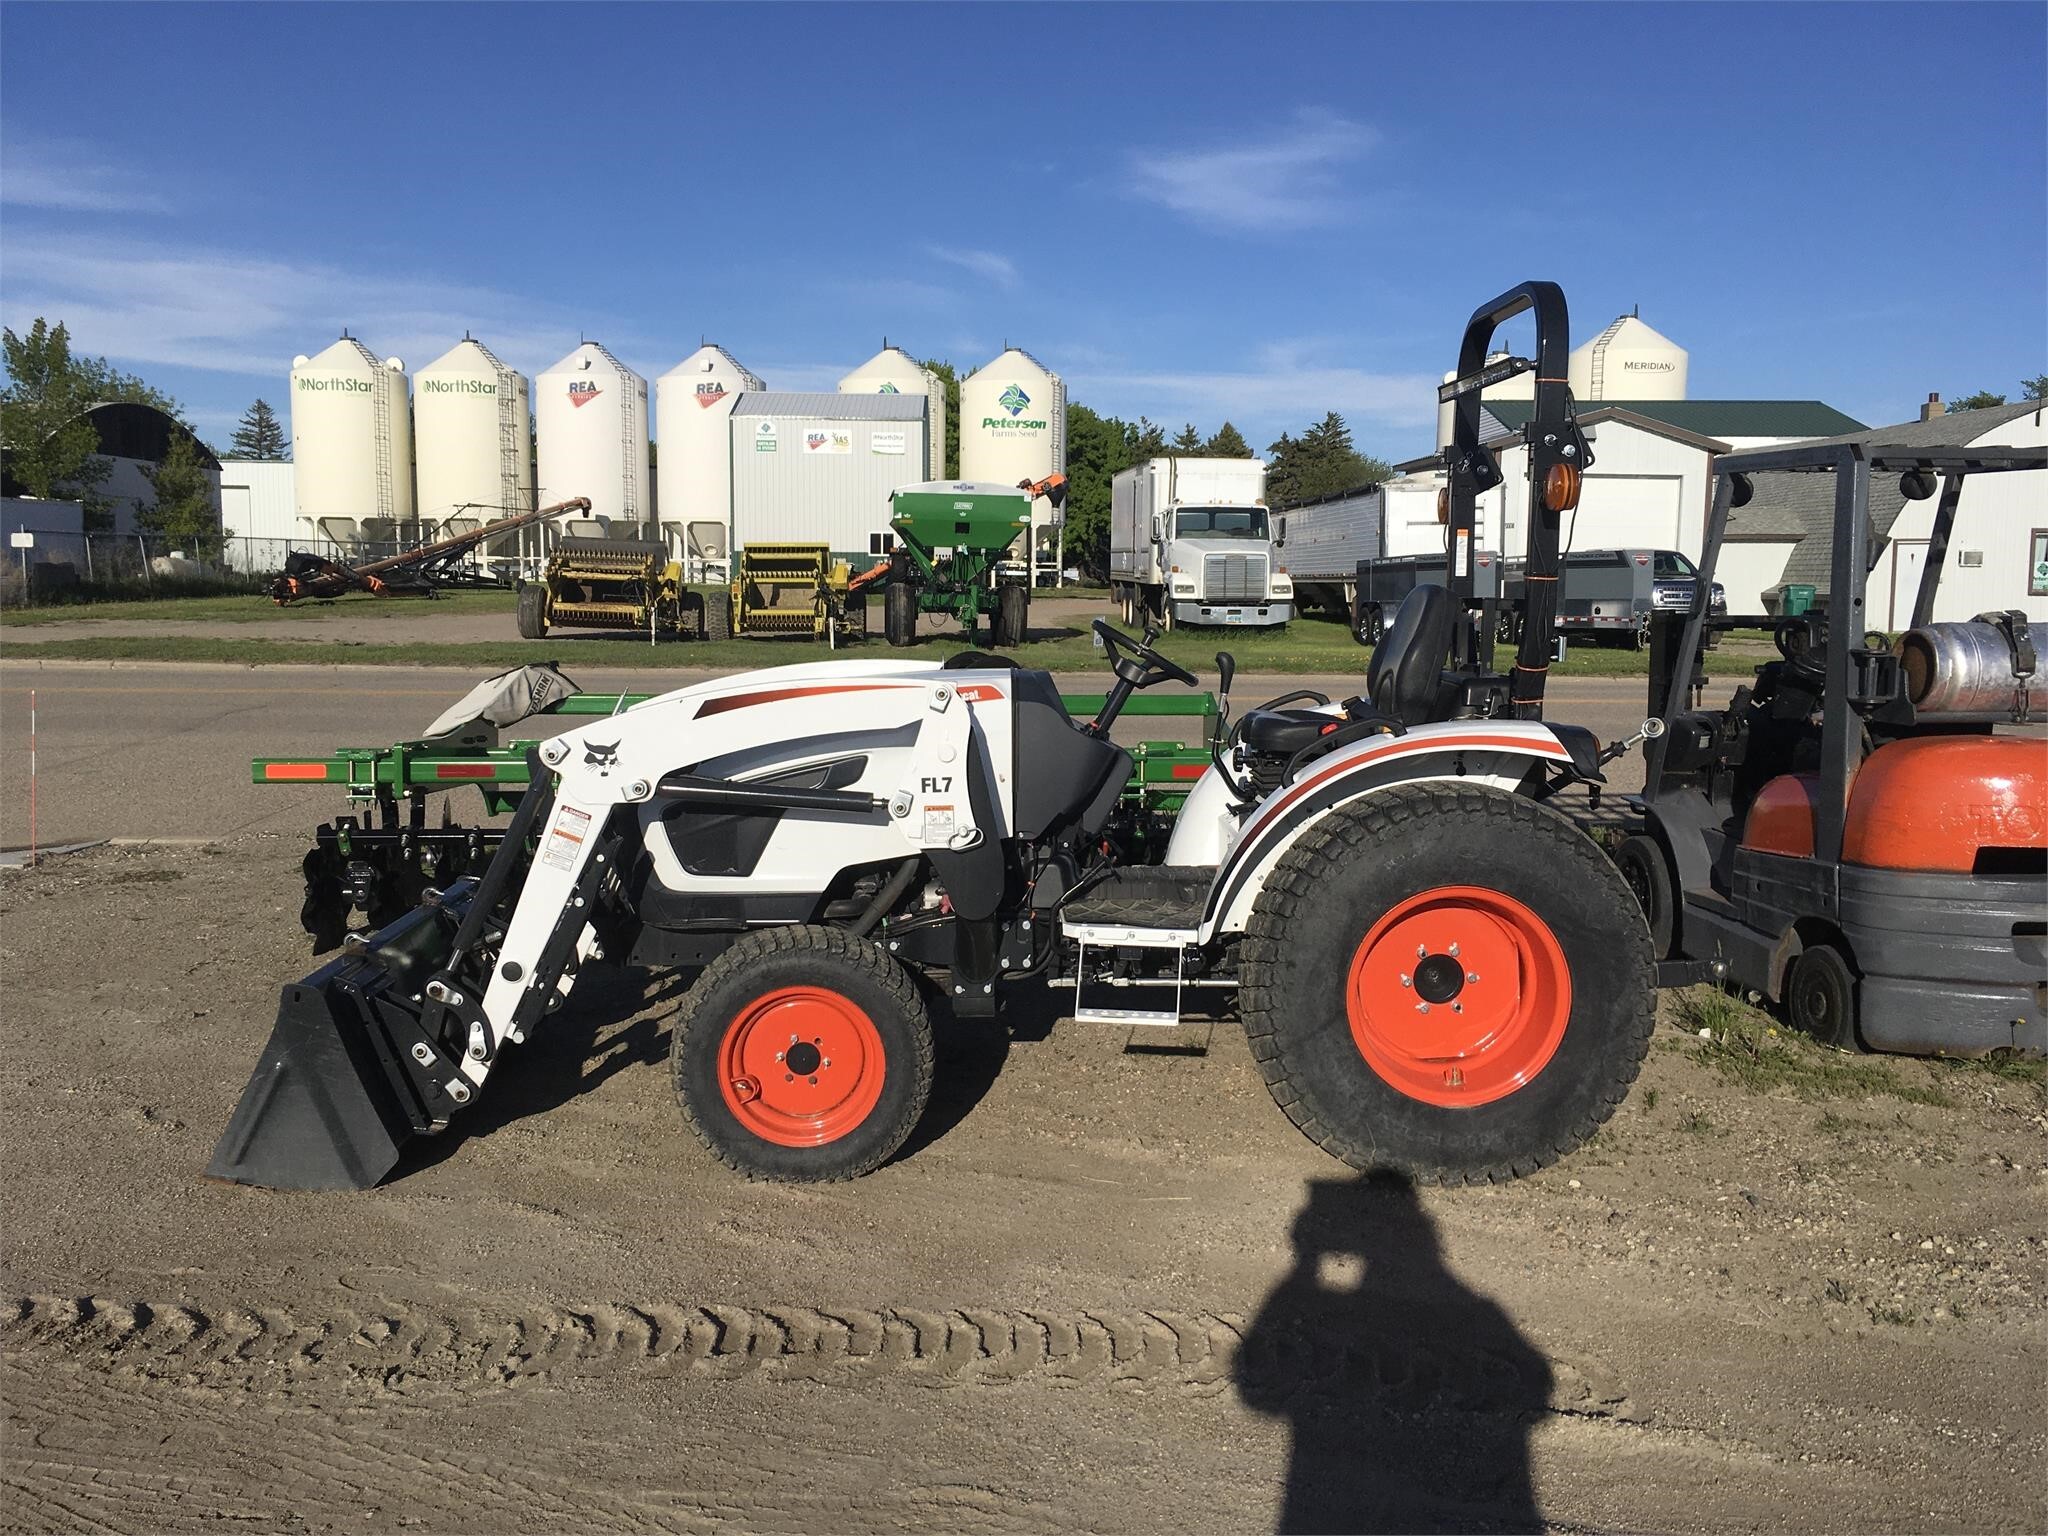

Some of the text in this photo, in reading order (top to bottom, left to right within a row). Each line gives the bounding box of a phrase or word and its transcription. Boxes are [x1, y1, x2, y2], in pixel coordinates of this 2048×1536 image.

[1624, 361, 1671, 370] MERIDIAN
[306, 378, 374, 392] NorthStar
[431, 379, 497, 394] NorthStar
[569, 381, 596, 393] REA
[697, 382, 723, 394] REA
[982, 417, 1047, 430] Peterson
[808, 433, 825, 441] REA
[921, 777, 953, 793] FL7
